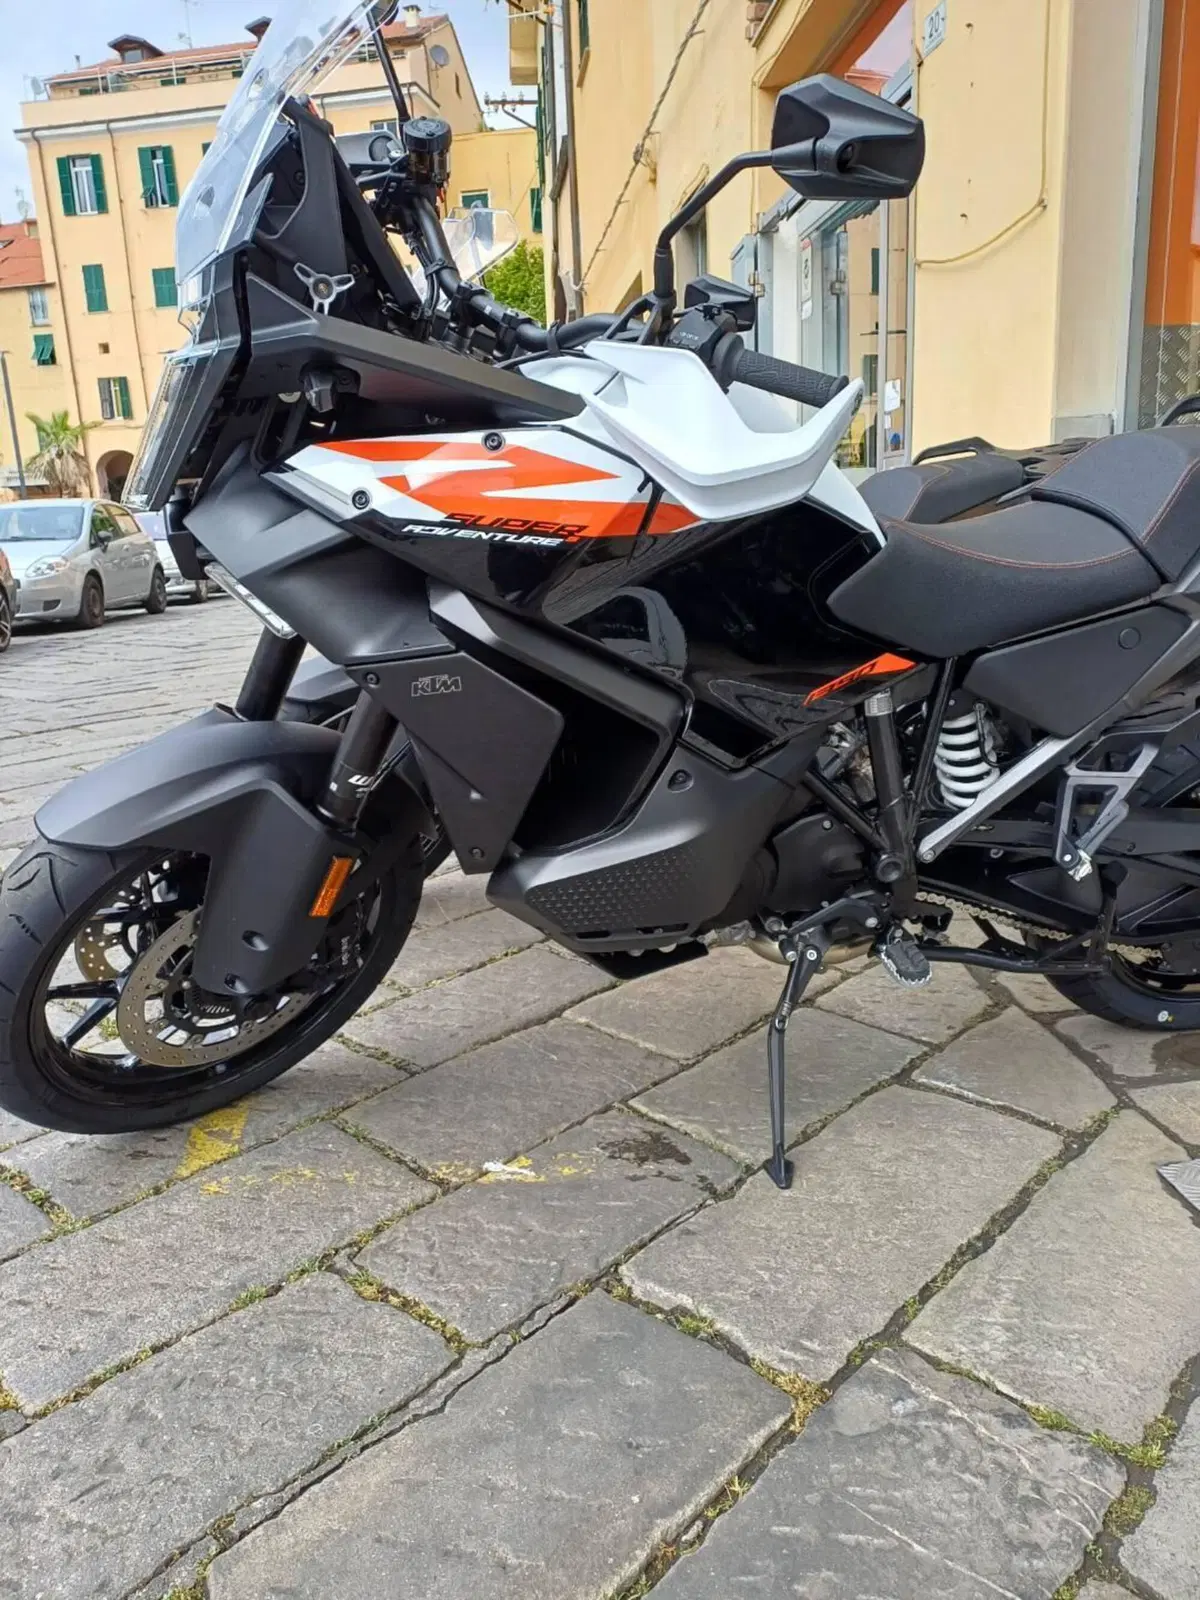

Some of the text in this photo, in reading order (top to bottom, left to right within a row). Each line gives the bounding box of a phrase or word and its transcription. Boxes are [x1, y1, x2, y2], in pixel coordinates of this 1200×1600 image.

[928, 10, 940, 39] 20
[401, 524, 564, 547] ADVENTURE
[440, 511, 588, 543] SUPER
[411, 674, 462, 697] KTM
